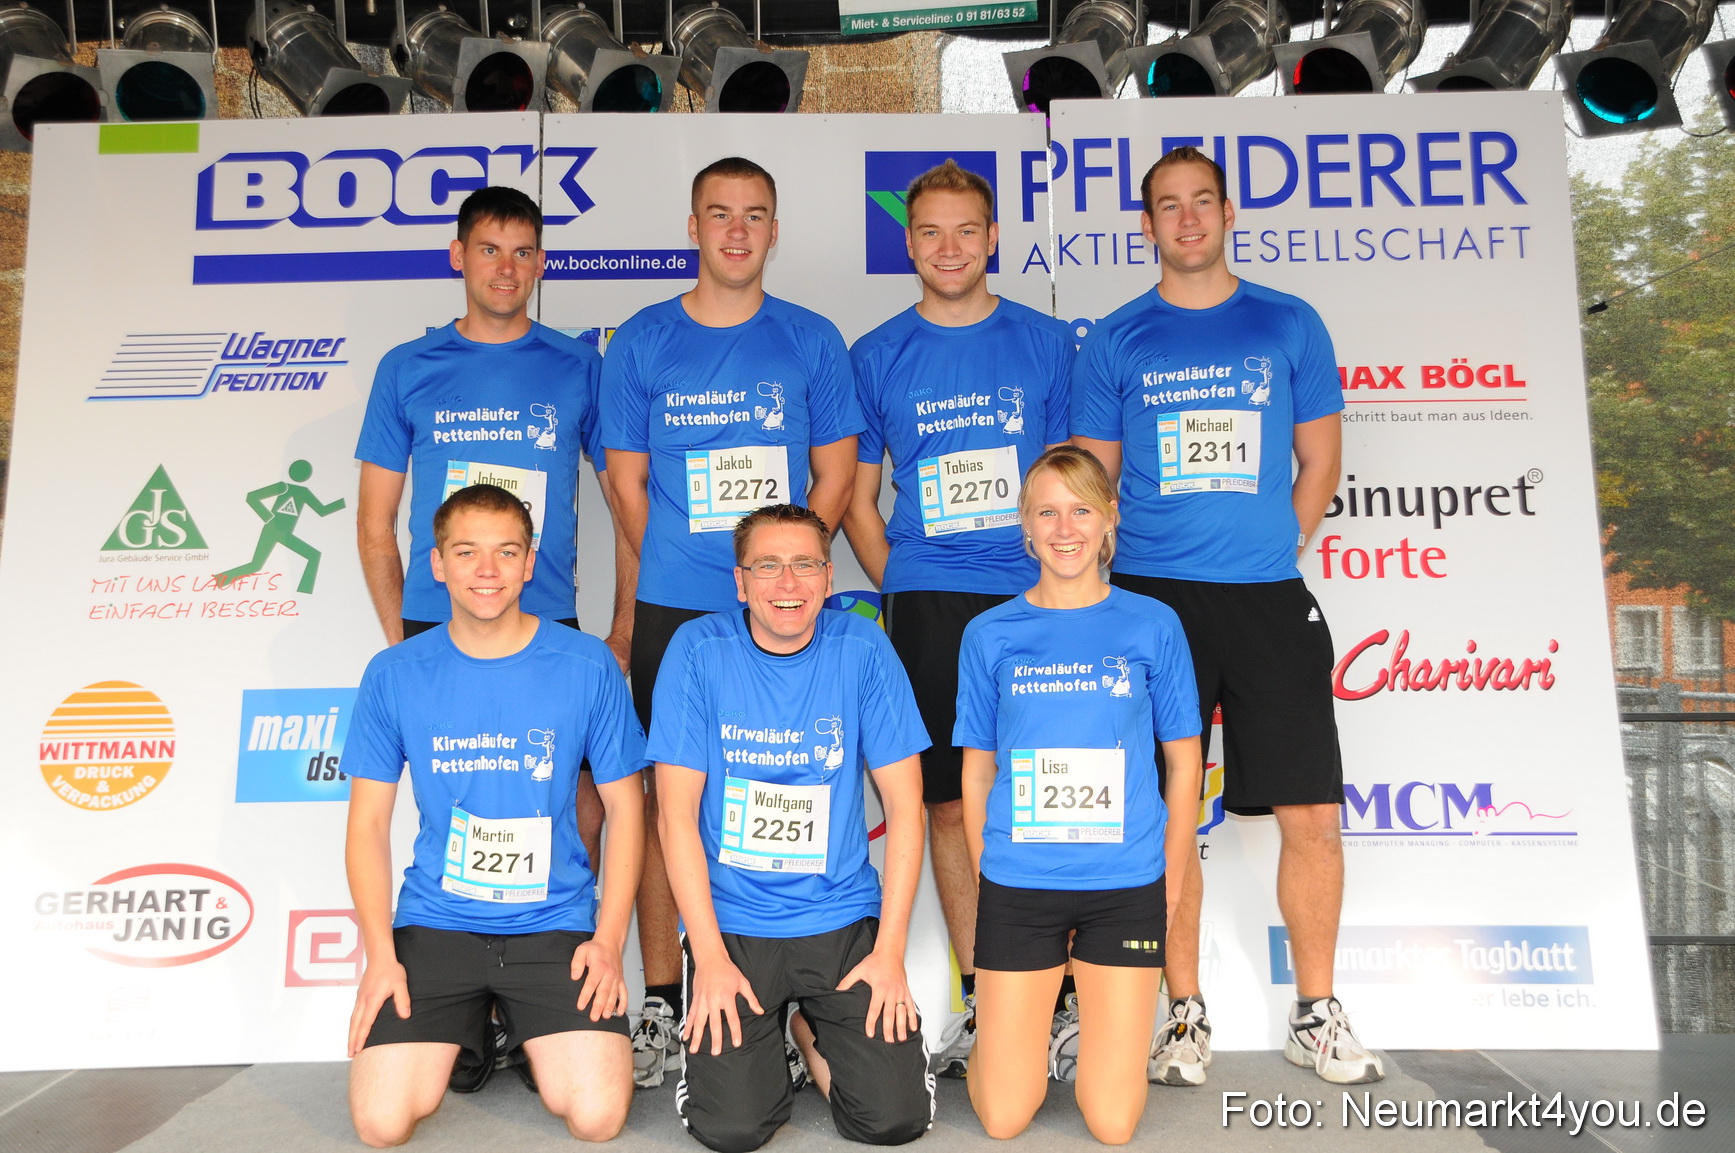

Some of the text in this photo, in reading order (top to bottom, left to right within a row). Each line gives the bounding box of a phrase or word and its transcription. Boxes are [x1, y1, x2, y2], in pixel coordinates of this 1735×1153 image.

[851, 7, 1025, 30] Miet- & Serviceline: 0 91 81/63 52
[196, 144, 598, 230] BOCK
[1021, 131, 1528, 222] PFLIDERER
[1021, 226, 1530, 274] AKTIEESELLSCHAFT
[221, 331, 347, 367] Wagner
[1142, 365, 1232, 387] Kirwaläufer
[1421, 358, 1526, 389] BÖGL
[666, 389, 747, 408] Kirwaläufer
[908, 387, 933, 399] JAKO
[916, 392, 991, 416] Kirwaläufer
[1142, 385, 1236, 407] Pettenhofen
[435, 408, 520, 424] Kirwaläufer
[664, 410, 750, 427] Pettenhofen
[917, 413, 995, 437] Pettenhofen
[1186, 417, 1233, 433] Michael
[1391, 410, 1423, 422] baut
[1427, 413, 1457, 422] man
[1461, 413, 1486, 421] aus
[1490, 410, 1533, 421] Ideen.
[433, 427, 523, 444] Pettenhofen
[716, 455, 752, 471] Jakob
[1188, 441, 1246, 463] 2311
[944, 459, 984, 475] Tobias
[719, 479, 778, 501] 2272
[949, 478, 1009, 505] 2270
[99, 553, 209, 563] Jura Gebäude Service GmbH
[1317, 535, 1447, 579] forte
[136, 575, 186, 593] UNS
[200, 600, 299, 618] BESSER.
[1014, 662, 1093, 678] Kirwaläufer
[1331, 629, 1559, 701] Charivari
[1011, 679, 1097, 696] Pettenhofen
[248, 707, 339, 751] maxi
[721, 724, 804, 744] Kirwaläufer
[40, 740, 176, 760] WITTMANN
[432, 733, 518, 752] Kirwaläufer
[74, 765, 135, 780] DRUCK
[432, 755, 519, 774] Pettenhofen
[1041, 758, 1068, 774] Lisa
[51, 775, 157, 808] VERPACKUNG
[96, 780, 110, 793] &
[1043, 785, 1111, 809] 2324
[755, 790, 813, 813] Wolfgang
[1341, 781, 1494, 830] MCM
[472, 825, 514, 843] Martin
[751, 817, 814, 842] 2251
[472, 850, 534, 874] 2271
[35, 889, 228, 915] GERHART &
[35, 920, 115, 931] Autohaus
[113, 916, 231, 942] JÄNIG
[1453, 939, 1576, 974] Tagblatt
[1502, 988, 1550, 1008] lebe
[1556, 988, 1597, 1008] ich.
